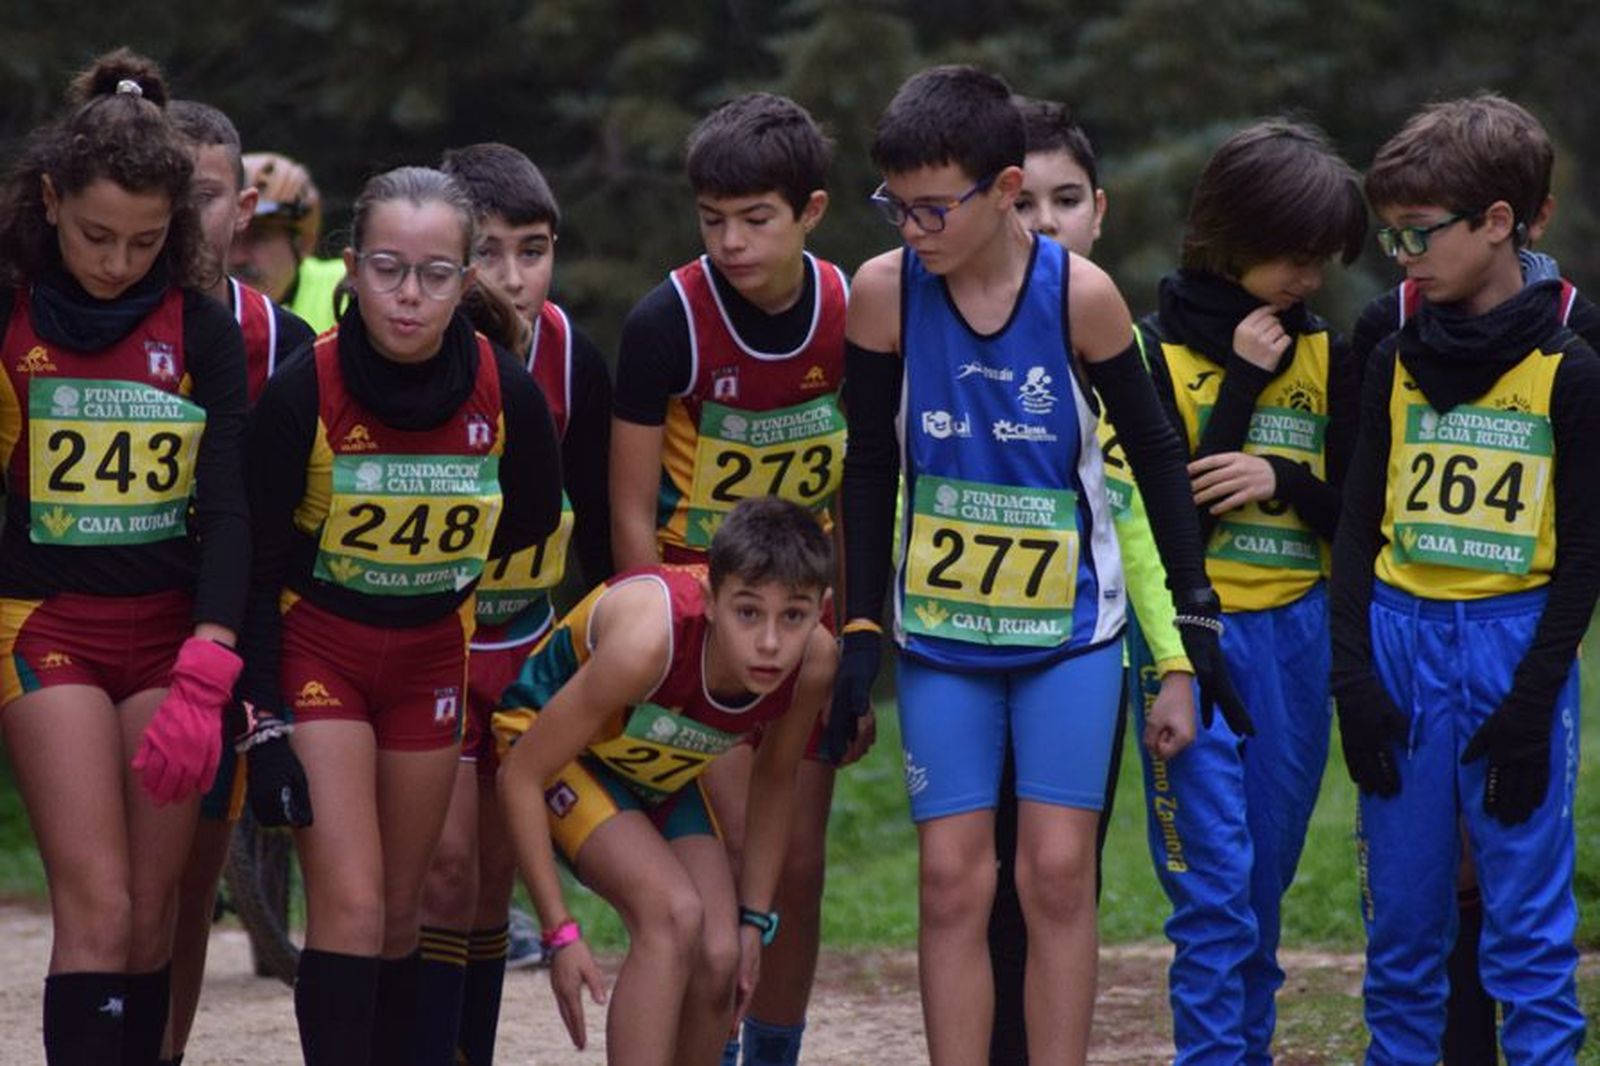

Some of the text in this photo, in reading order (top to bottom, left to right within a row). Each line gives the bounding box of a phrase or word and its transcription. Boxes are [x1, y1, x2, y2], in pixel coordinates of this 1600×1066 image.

[84, 403, 184, 419] CAJA RURAL
[752, 404, 832, 431] FUNDACION
[750, 419, 834, 446] CAJA RURAL
[1437, 426, 1531, 450] CAJA RURAL
[47, 430, 183, 494] 243
[387, 463, 480, 478] FUNDACION
[711, 444, 832, 502] 273
[387, 479, 481, 493] CAJA RURAL
[1406, 452, 1526, 523] 264
[962, 490, 1057, 513] FUNDACION
[77, 516, 124, 534] CAJA
[961, 506, 1057, 527] CAJA RURAL
[341, 503, 481, 555] 248
[1234, 534, 1278, 554] CAJA
[1417, 534, 1526, 562] CAJA RURAL
[926, 529, 1059, 598] 277
[364, 570, 410, 586] CAJA
[952, 613, 1063, 635] CAJA RURAL
[607, 747, 706, 783] 27
